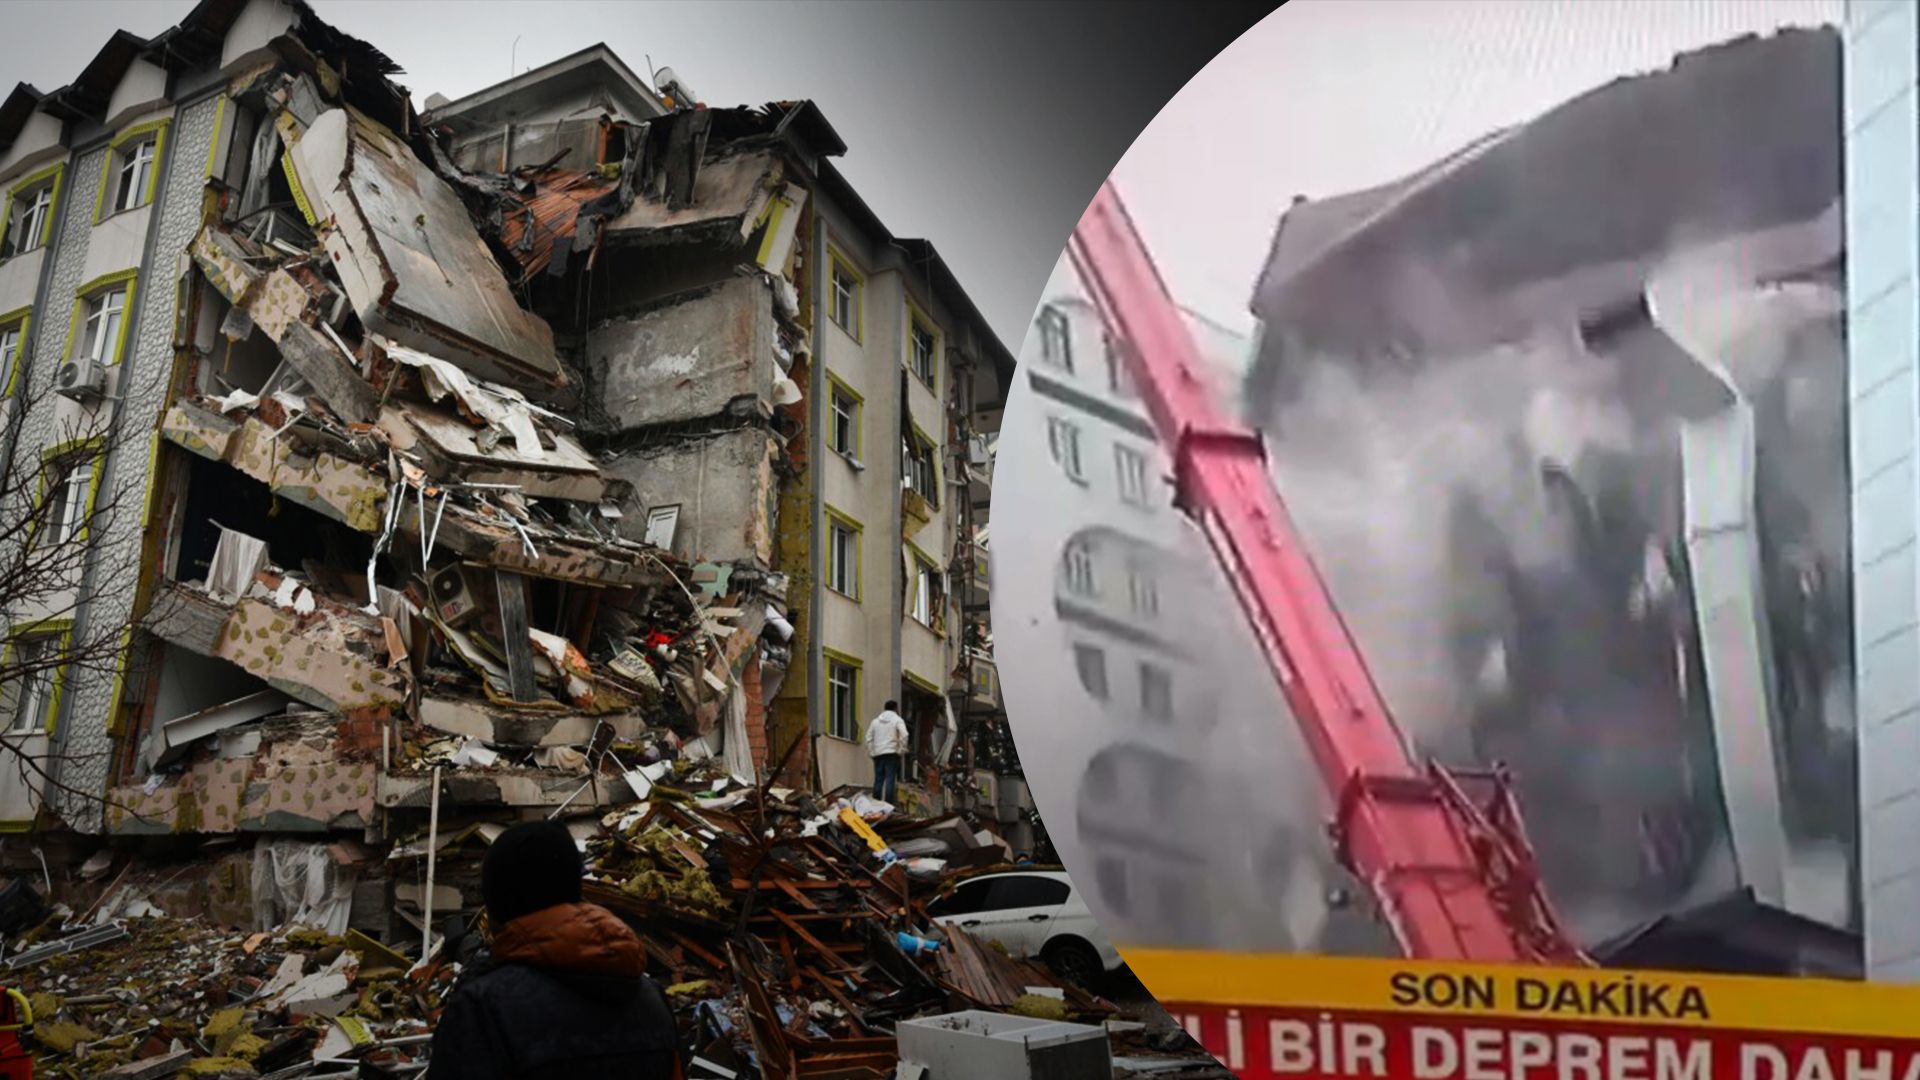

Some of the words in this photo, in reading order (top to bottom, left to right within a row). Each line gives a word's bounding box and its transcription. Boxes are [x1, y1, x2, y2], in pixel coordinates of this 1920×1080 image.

[1390, 972, 1495, 1008] SON
[1515, 975, 1711, 1019] DAKİKA
[1171, 1009, 1244, 1069] Lİ
[1269, 1013, 1387, 1077] BİR
[1411, 1026, 1712, 1080] DEPREM
